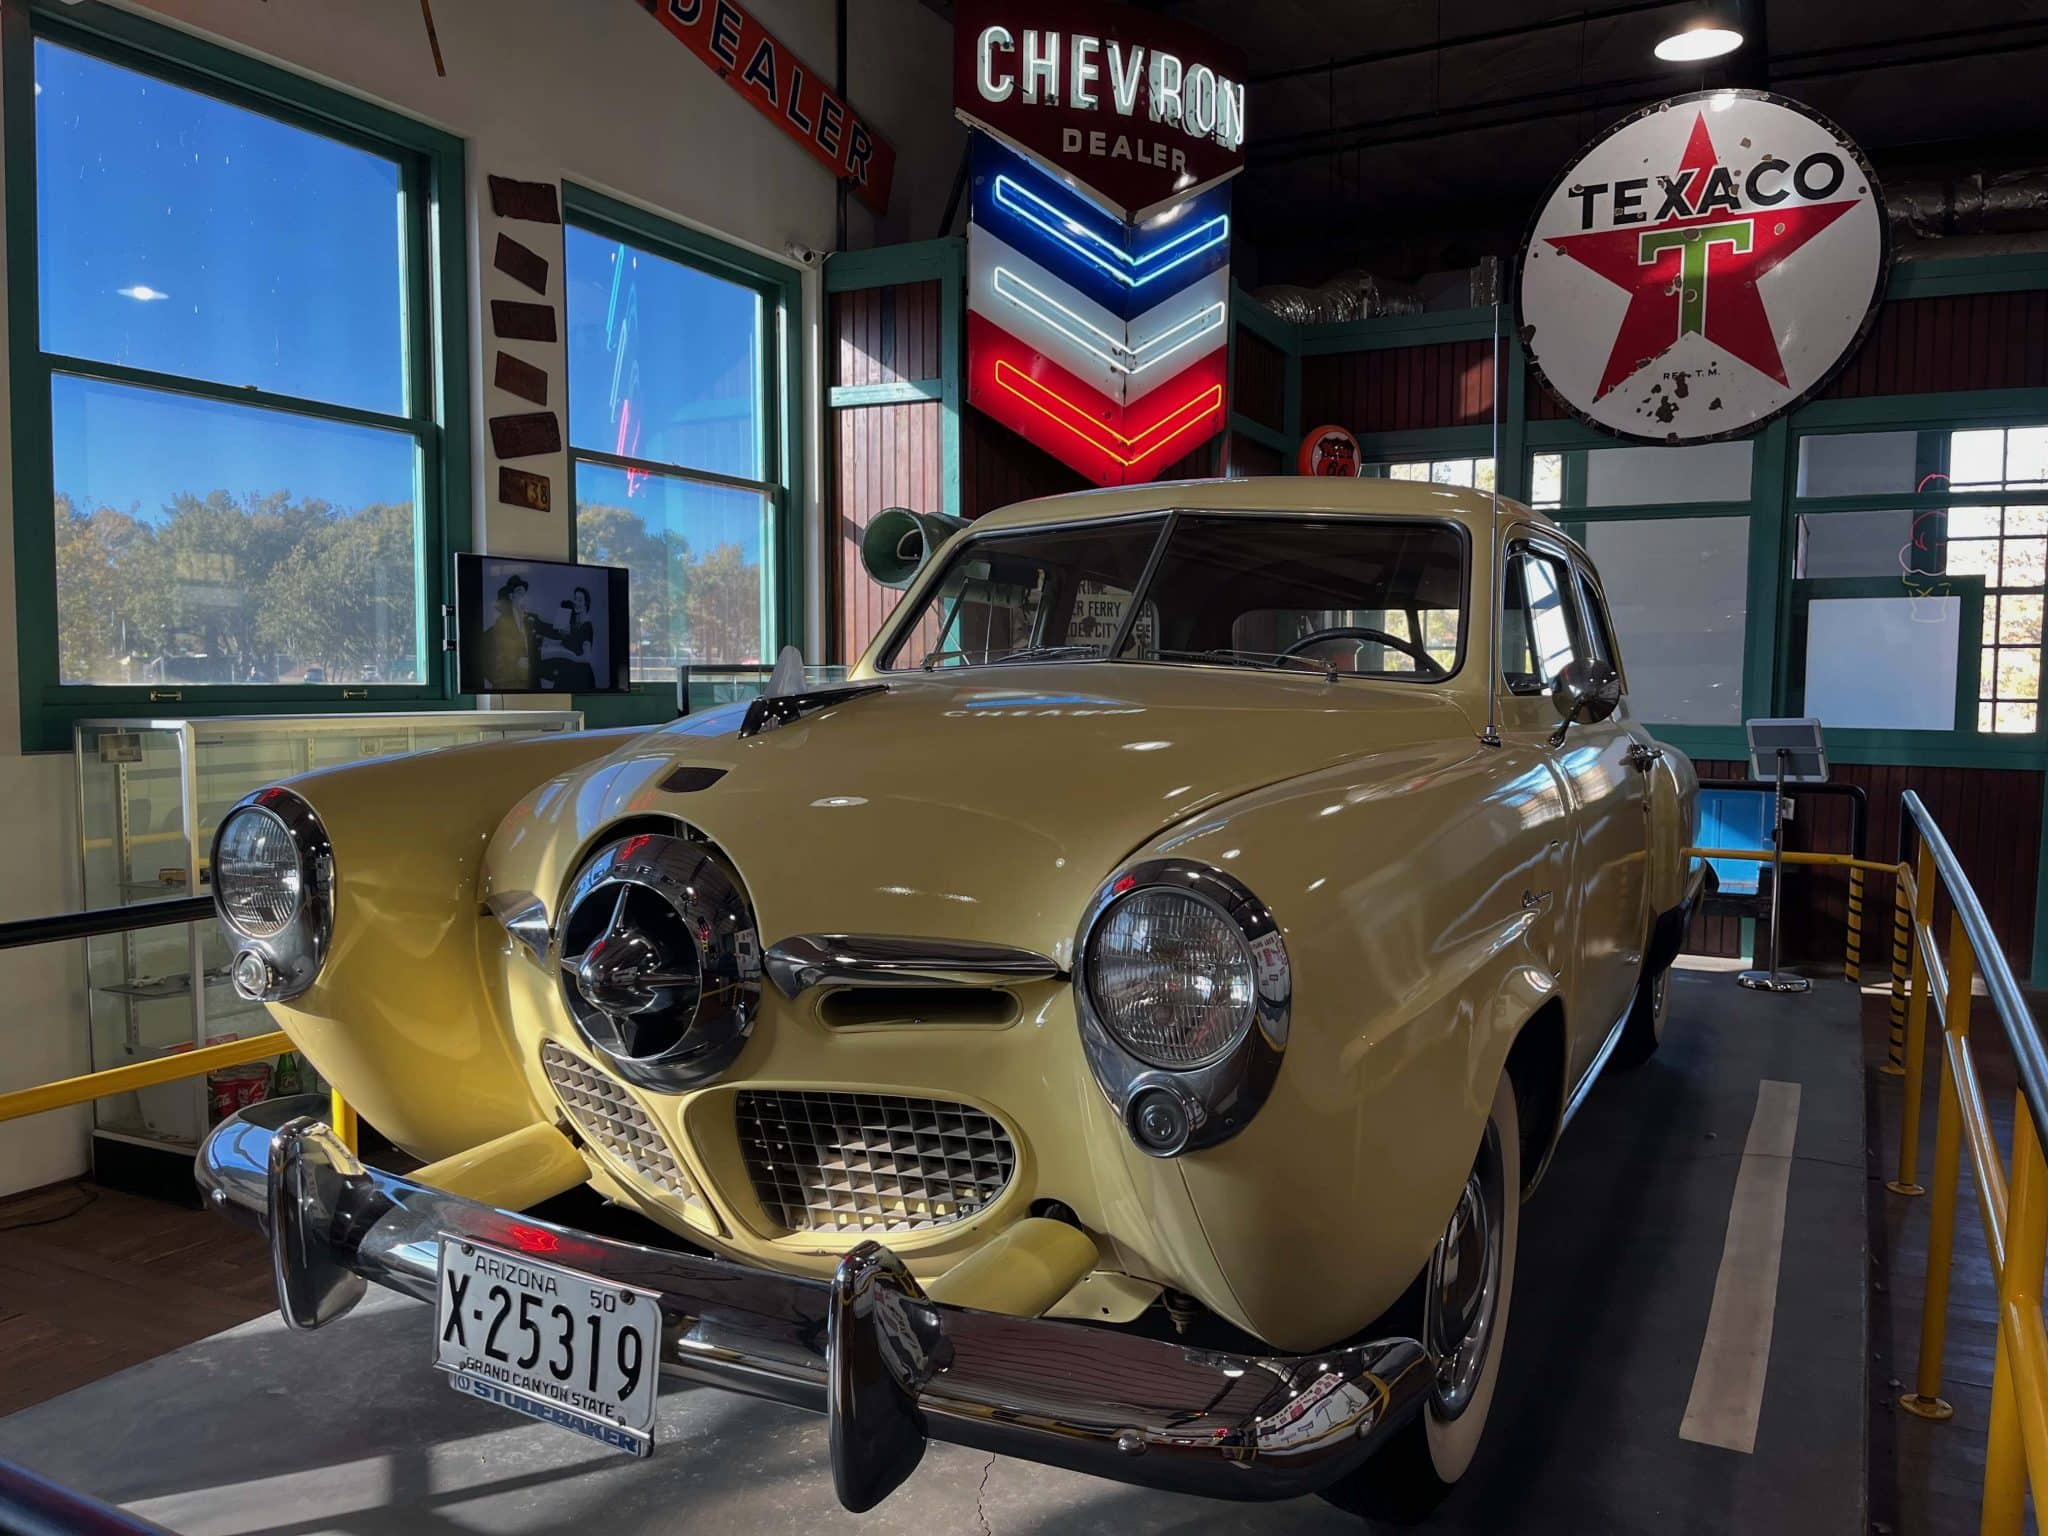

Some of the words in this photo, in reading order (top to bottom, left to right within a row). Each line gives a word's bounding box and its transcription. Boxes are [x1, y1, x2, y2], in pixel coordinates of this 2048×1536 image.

[977, 26, 1245, 152] CHEVRON
[1062, 127, 1188, 173] DEALER
[1568, 152, 1845, 230] TEXACO
[1089, 601, 1121, 617] FERRY
[474, 1255, 558, 1297] ARIZONA
[589, 1289, 616, 1313] 50
[443, 1270, 642, 1402] X-25319
[465, 1357, 510, 1384] GRAND
[512, 1373, 569, 1403] CANYON
[571, 1392, 616, 1418] STATE
[473, 1380, 637, 1452] STUDEBAKER
